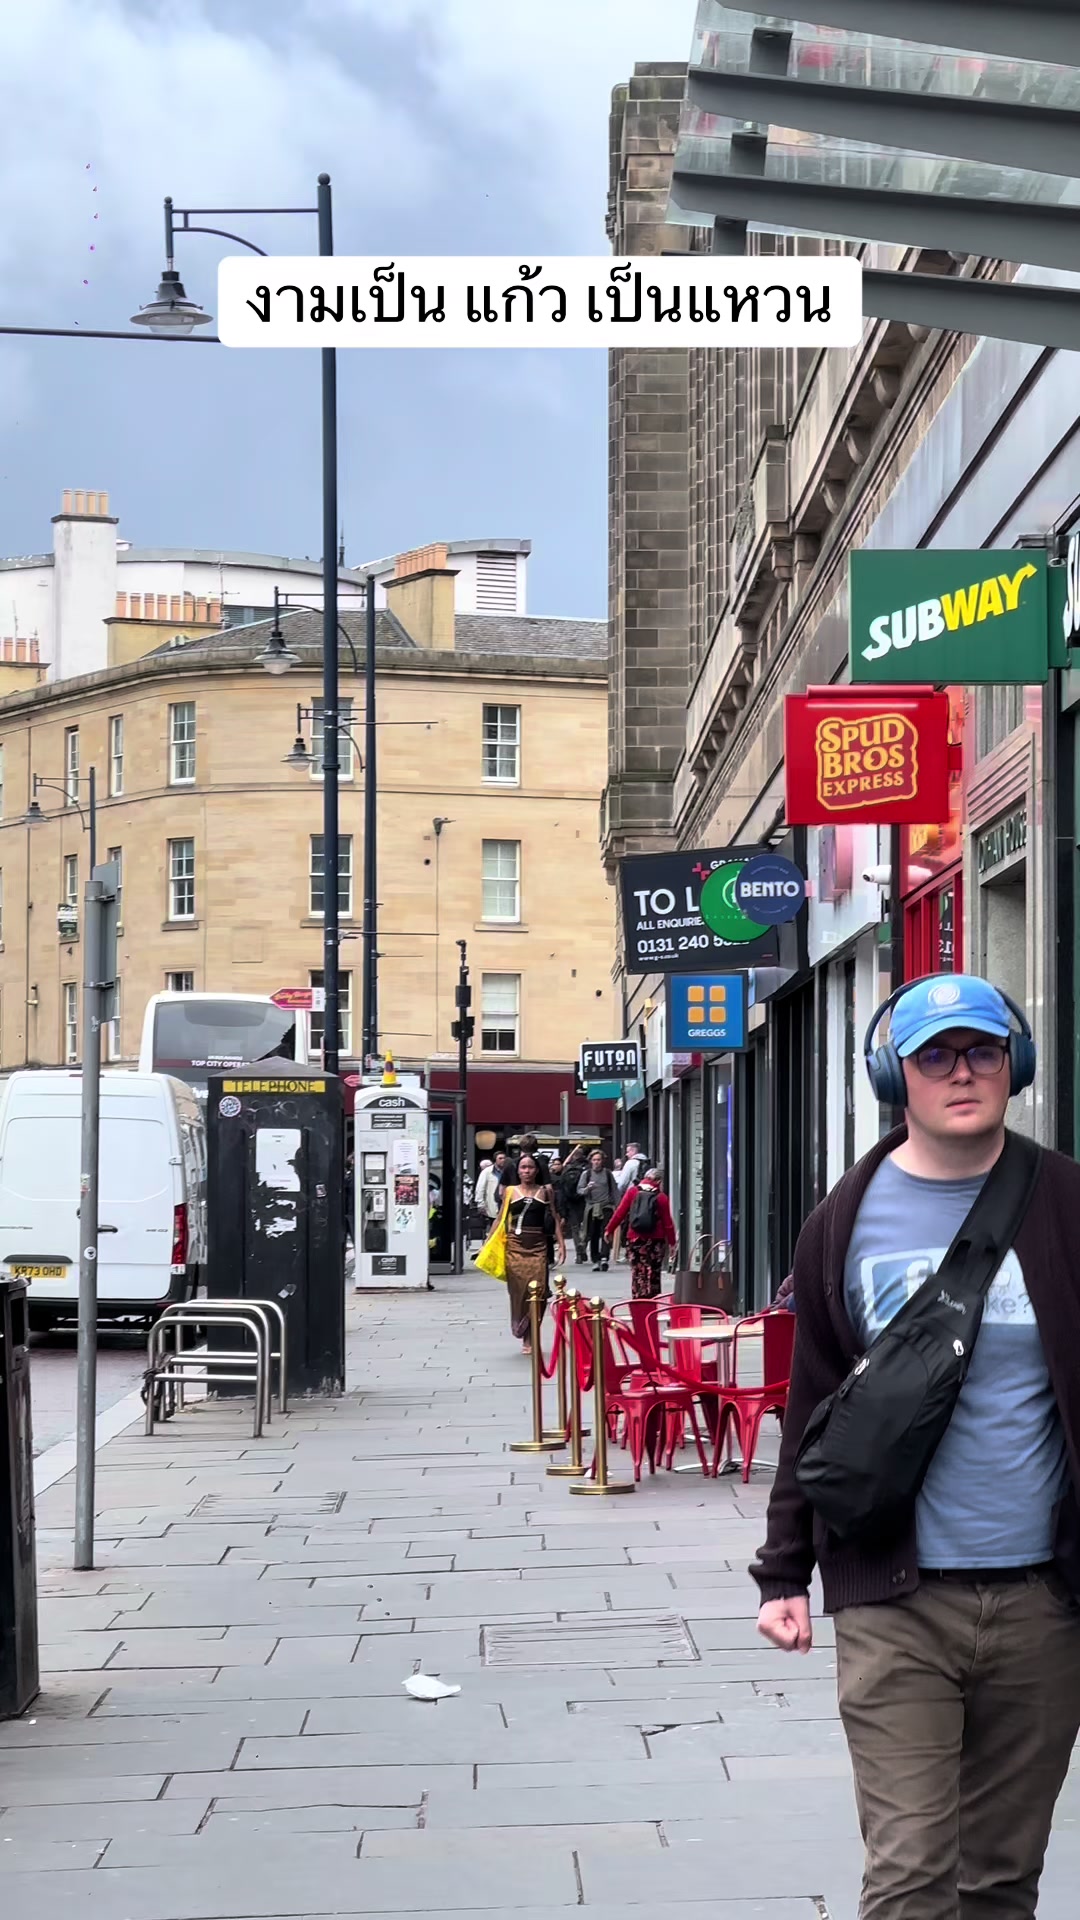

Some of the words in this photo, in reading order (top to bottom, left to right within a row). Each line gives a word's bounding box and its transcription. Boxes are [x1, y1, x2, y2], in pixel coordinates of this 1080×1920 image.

[861, 562, 1038, 662] SUBWAY
[821, 718, 905, 753] SPUD
[823, 744, 905, 779] BROS
[823, 771, 904, 797] EXPRESS
[740, 880, 800, 898] BENTO
[634, 888, 676, 917] TO
[636, 920, 656, 931] ALL
[657, 916, 705, 930] ENQUIRIE
[637, 938, 675, 954] 0131
[678, 934, 709, 951] 240
[688, 1028, 727, 1037] GREGGS
[584, 1049, 636, 1067] FUTON
[231, 1080, 316, 1092] TELEPHONE
[378, 1097, 406, 1107] cash
